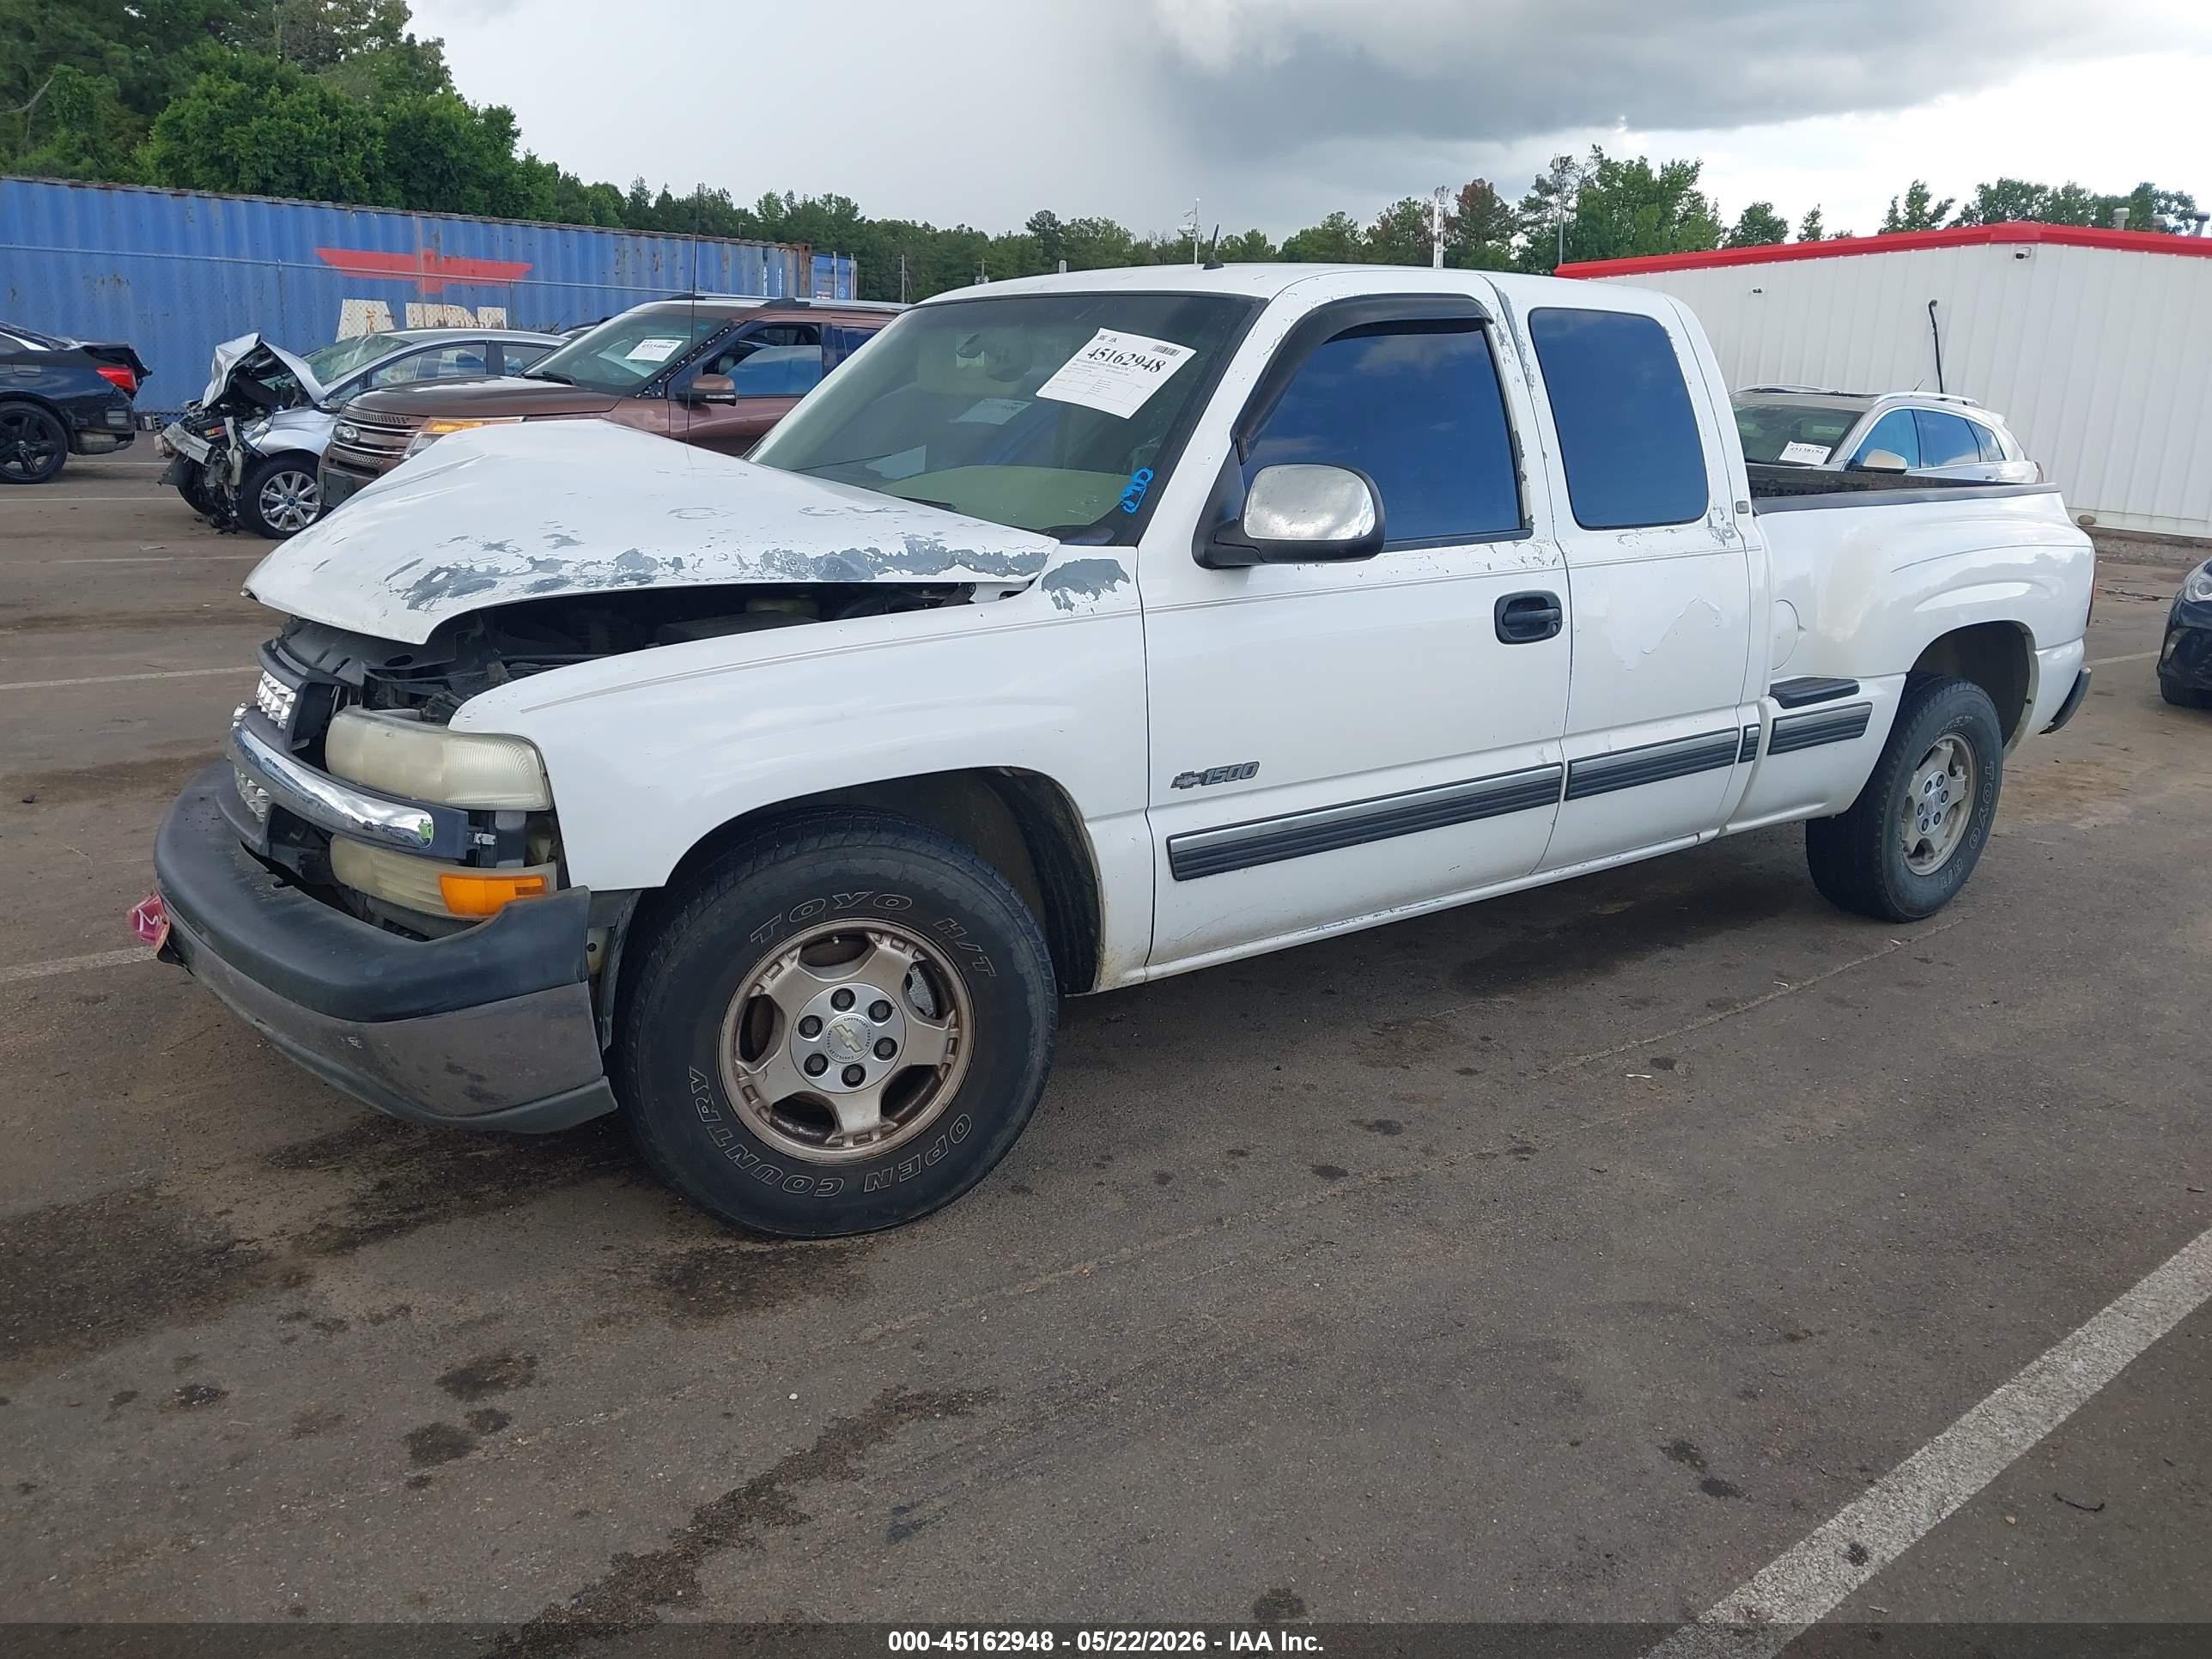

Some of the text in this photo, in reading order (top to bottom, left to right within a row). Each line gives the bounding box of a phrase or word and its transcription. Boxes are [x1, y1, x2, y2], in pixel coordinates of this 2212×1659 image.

[1086, 346, 1167, 374] 45162948
[1203, 763, 1260, 785] 1500
[1968, 762, 1995, 849] TOYO
[750, 890, 997, 977] TOYO H/T
[689, 1066, 972, 1198] OPEN COUNTRY
